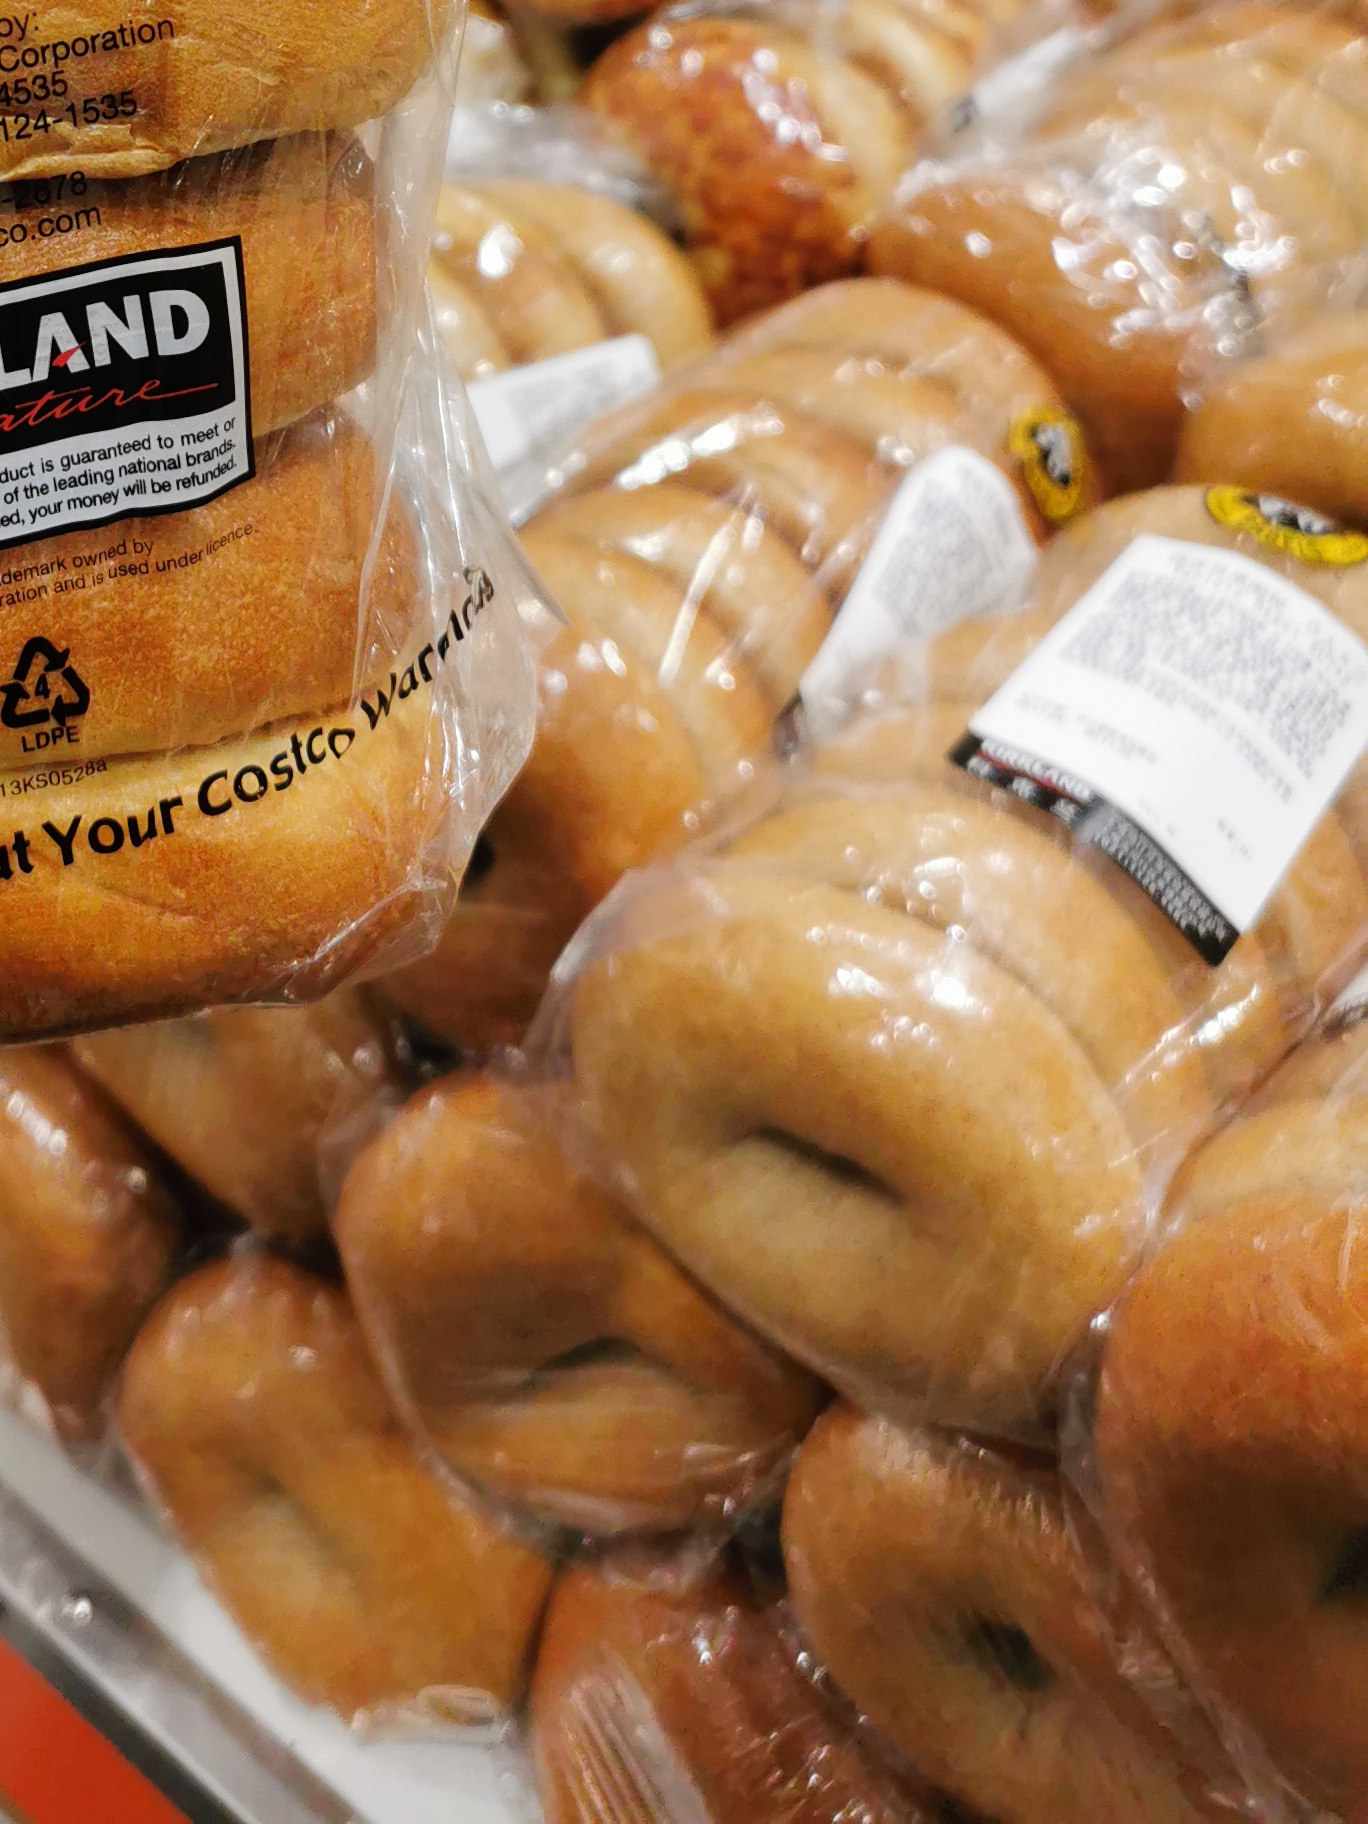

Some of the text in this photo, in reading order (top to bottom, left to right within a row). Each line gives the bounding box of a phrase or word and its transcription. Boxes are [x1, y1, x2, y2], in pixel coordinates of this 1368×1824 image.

[3, 486, 19, 504] of
[23, 483, 50, 500] the
[53, 468, 115, 492] leading
[118, 452, 182, 477] national
[185, 437, 236, 467] brands.
[40, 457, 55, 473] is
[60, 433, 151, 471] guaranteed
[156, 434, 175, 449] to
[181, 425, 220, 446] meet
[223, 416, 236, 432] or
[28, 499, 63, 524] your
[67, 487, 120, 511] money
[123, 479, 147, 497] will
[150, 478, 172, 494] be
[176, 456, 237, 491] refunded.
[53, 573, 87, 594] and
[92, 571, 105, 587] is
[108, 559, 149, 580] used
[155, 550, 203, 573] under
[206, 523, 258, 555] licence.
[72, 540, 128, 568] owned
[132, 537, 154, 558] by
[21, 725, 80, 753] LDPE
[43, 794, 184, 867] Your
[198, 725, 356, 818] Costco
